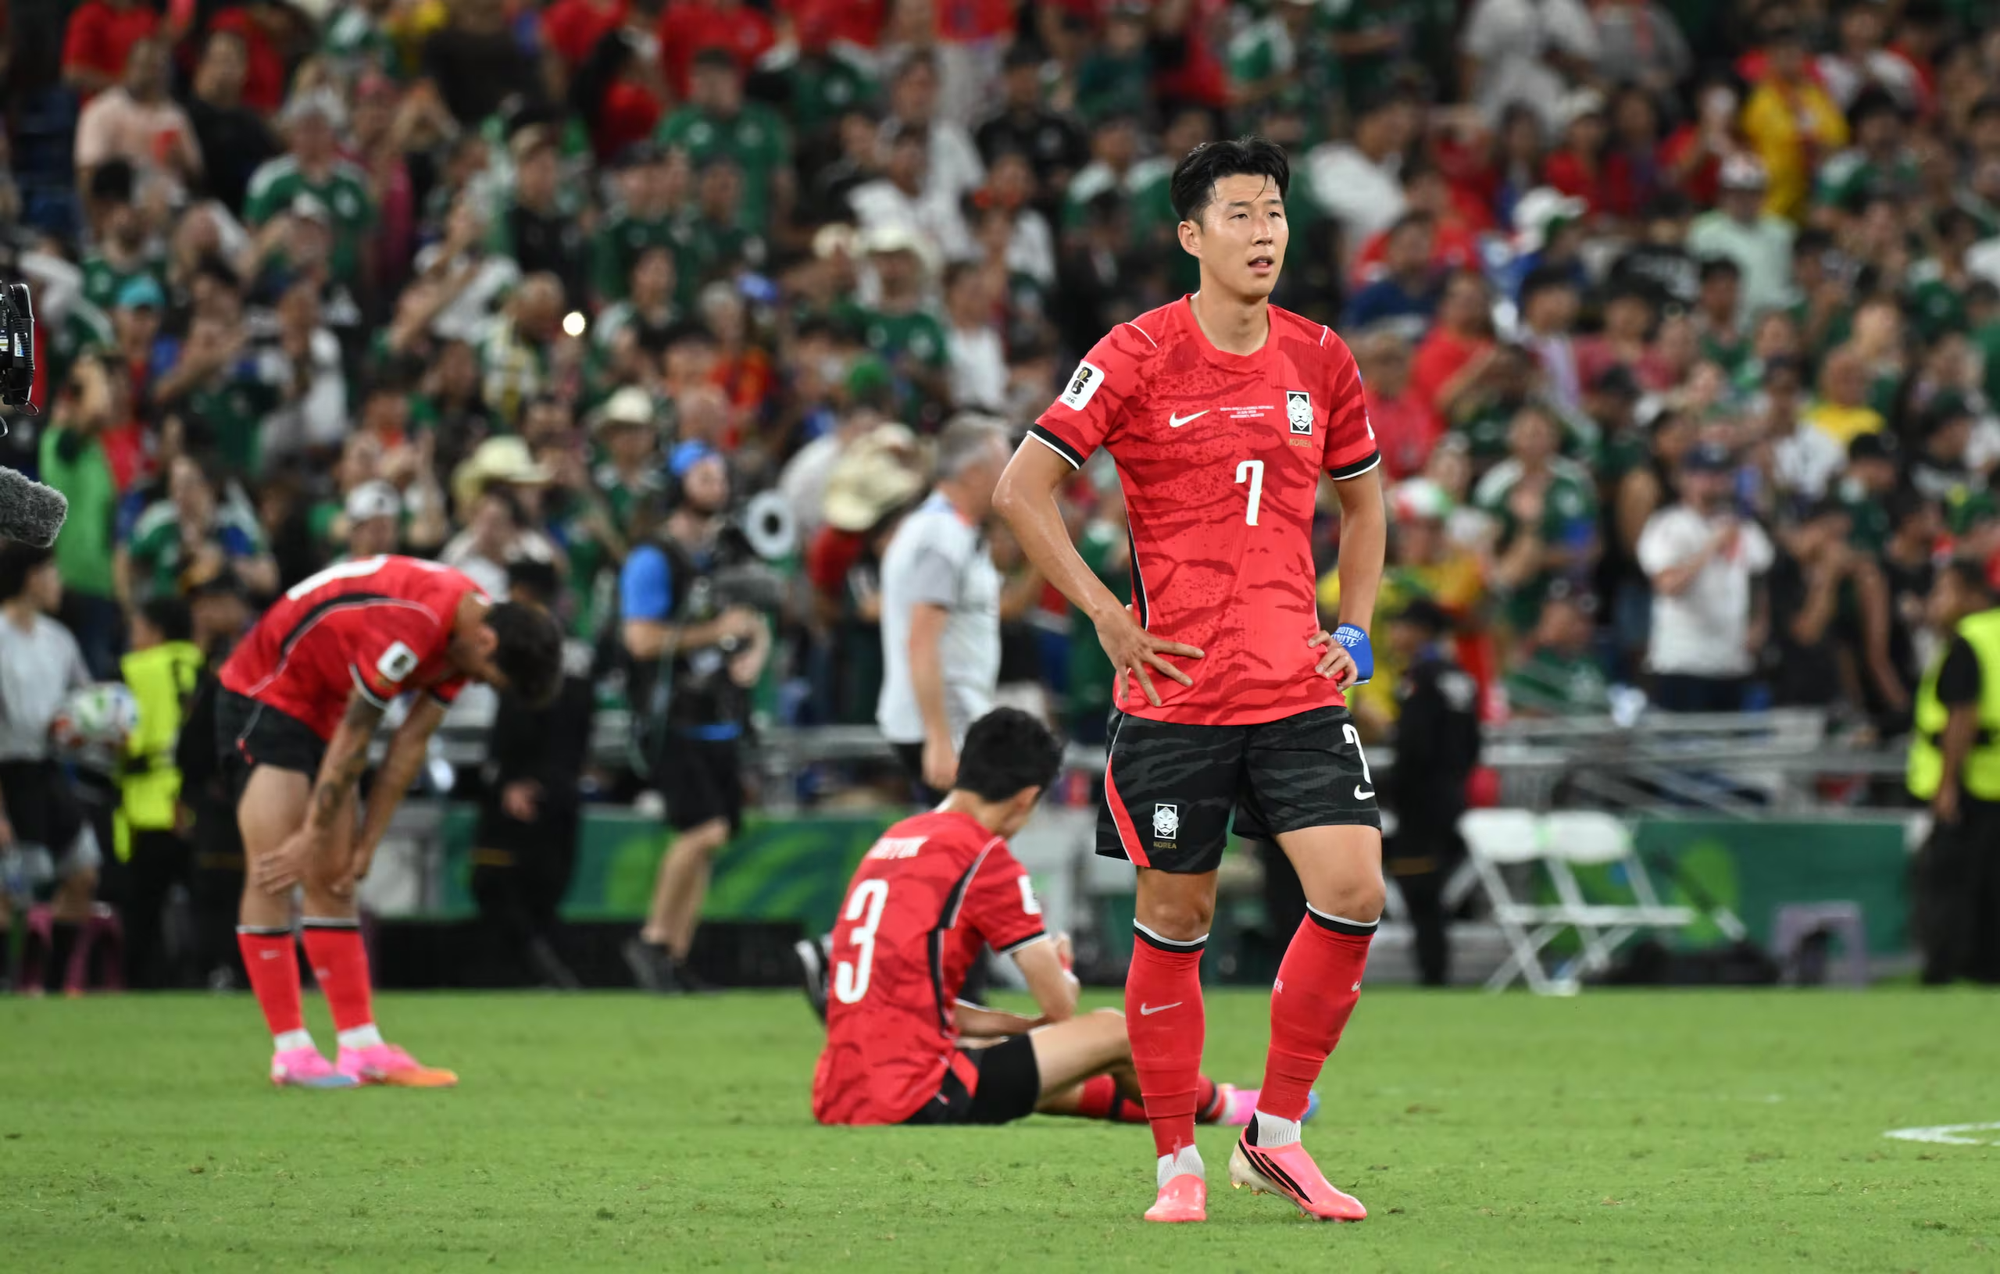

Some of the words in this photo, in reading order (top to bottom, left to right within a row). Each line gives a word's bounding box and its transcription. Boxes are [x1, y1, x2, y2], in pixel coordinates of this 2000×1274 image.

[1289, 438, 1312, 448] KOREA
[1234, 459, 1265, 526] 7
[1153, 841, 1177, 849] KOREA
[834, 878, 889, 1004] 3
